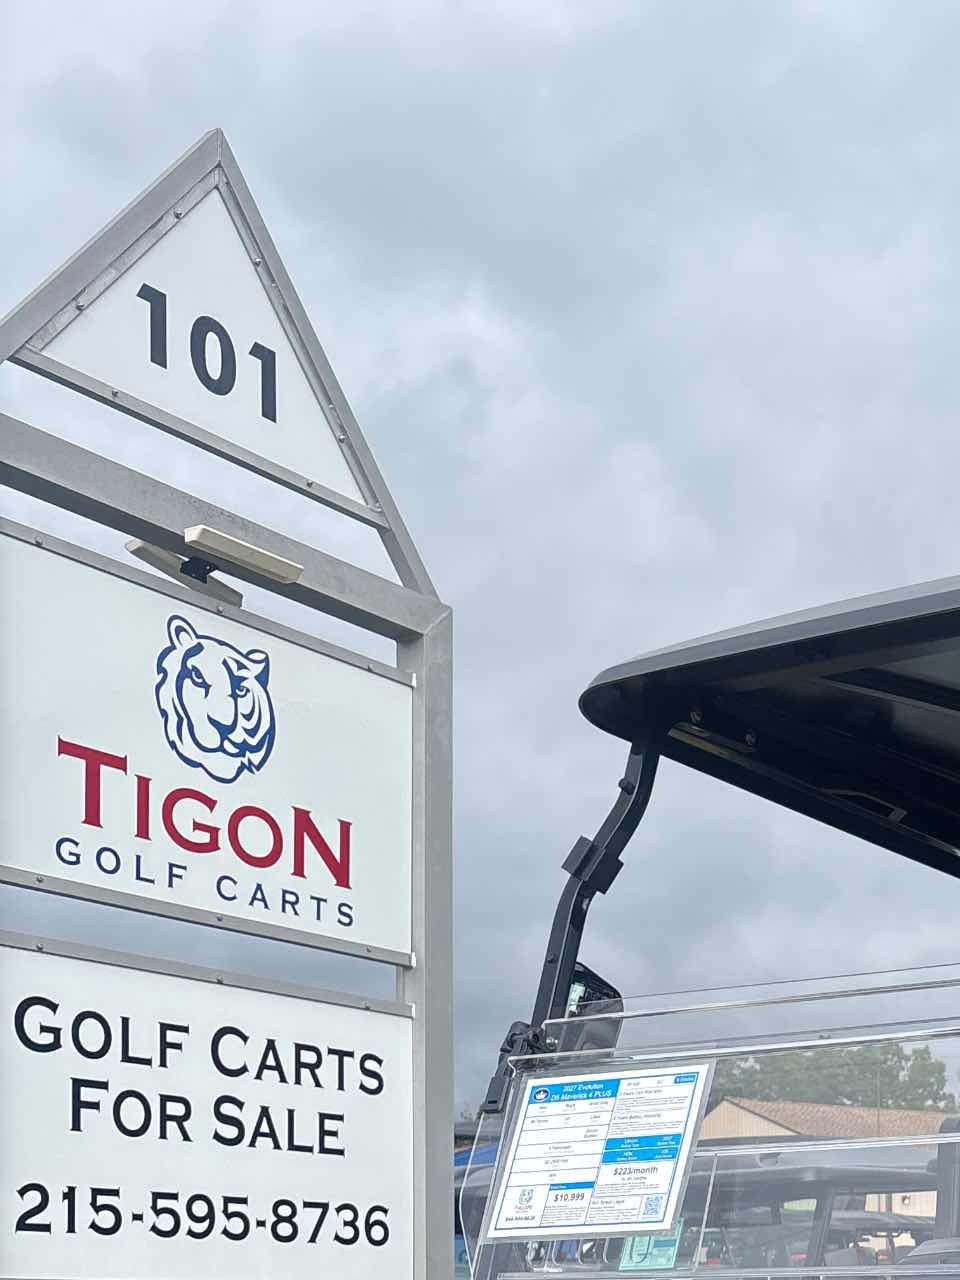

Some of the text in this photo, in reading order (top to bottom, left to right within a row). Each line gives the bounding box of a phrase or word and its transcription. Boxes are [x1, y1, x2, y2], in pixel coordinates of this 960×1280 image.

[135, 283, 277, 423] 101
[58, 735, 352, 889] TIGON
[55, 837, 354, 927] GOLF CARTS
[14, 996, 385, 1095] GOLF CARTS
[70, 1077, 346, 1157] FOR SALE
[15, 1182, 390, 1246] 215-595-8736
